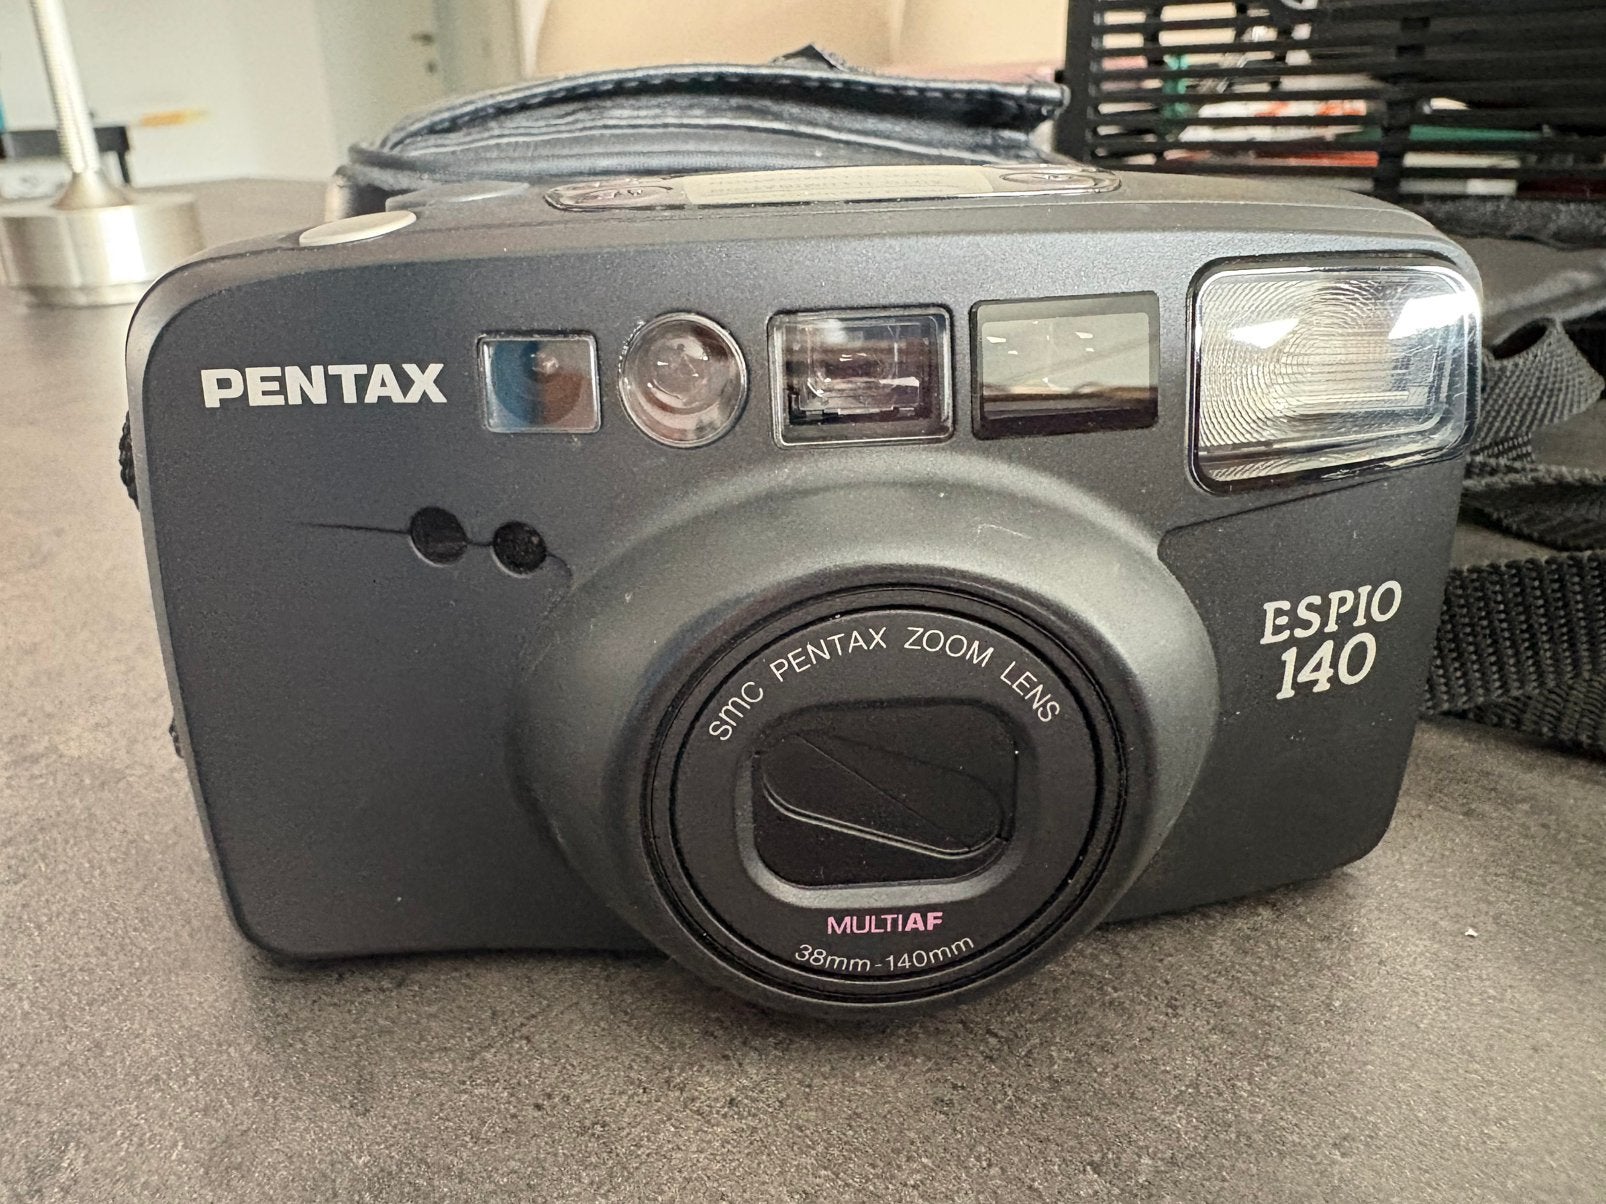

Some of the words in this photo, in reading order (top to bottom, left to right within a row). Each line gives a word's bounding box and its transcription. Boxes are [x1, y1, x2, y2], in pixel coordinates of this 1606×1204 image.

[201, 363, 447, 408] PENTAX
[1260, 580, 1402, 645] ESPIO
[769, 626, 888, 682] PENTAX
[904, 627, 995, 668] ZOOM
[1000, 661, 1061, 722] LENS
[1276, 632, 1376, 700] 140
